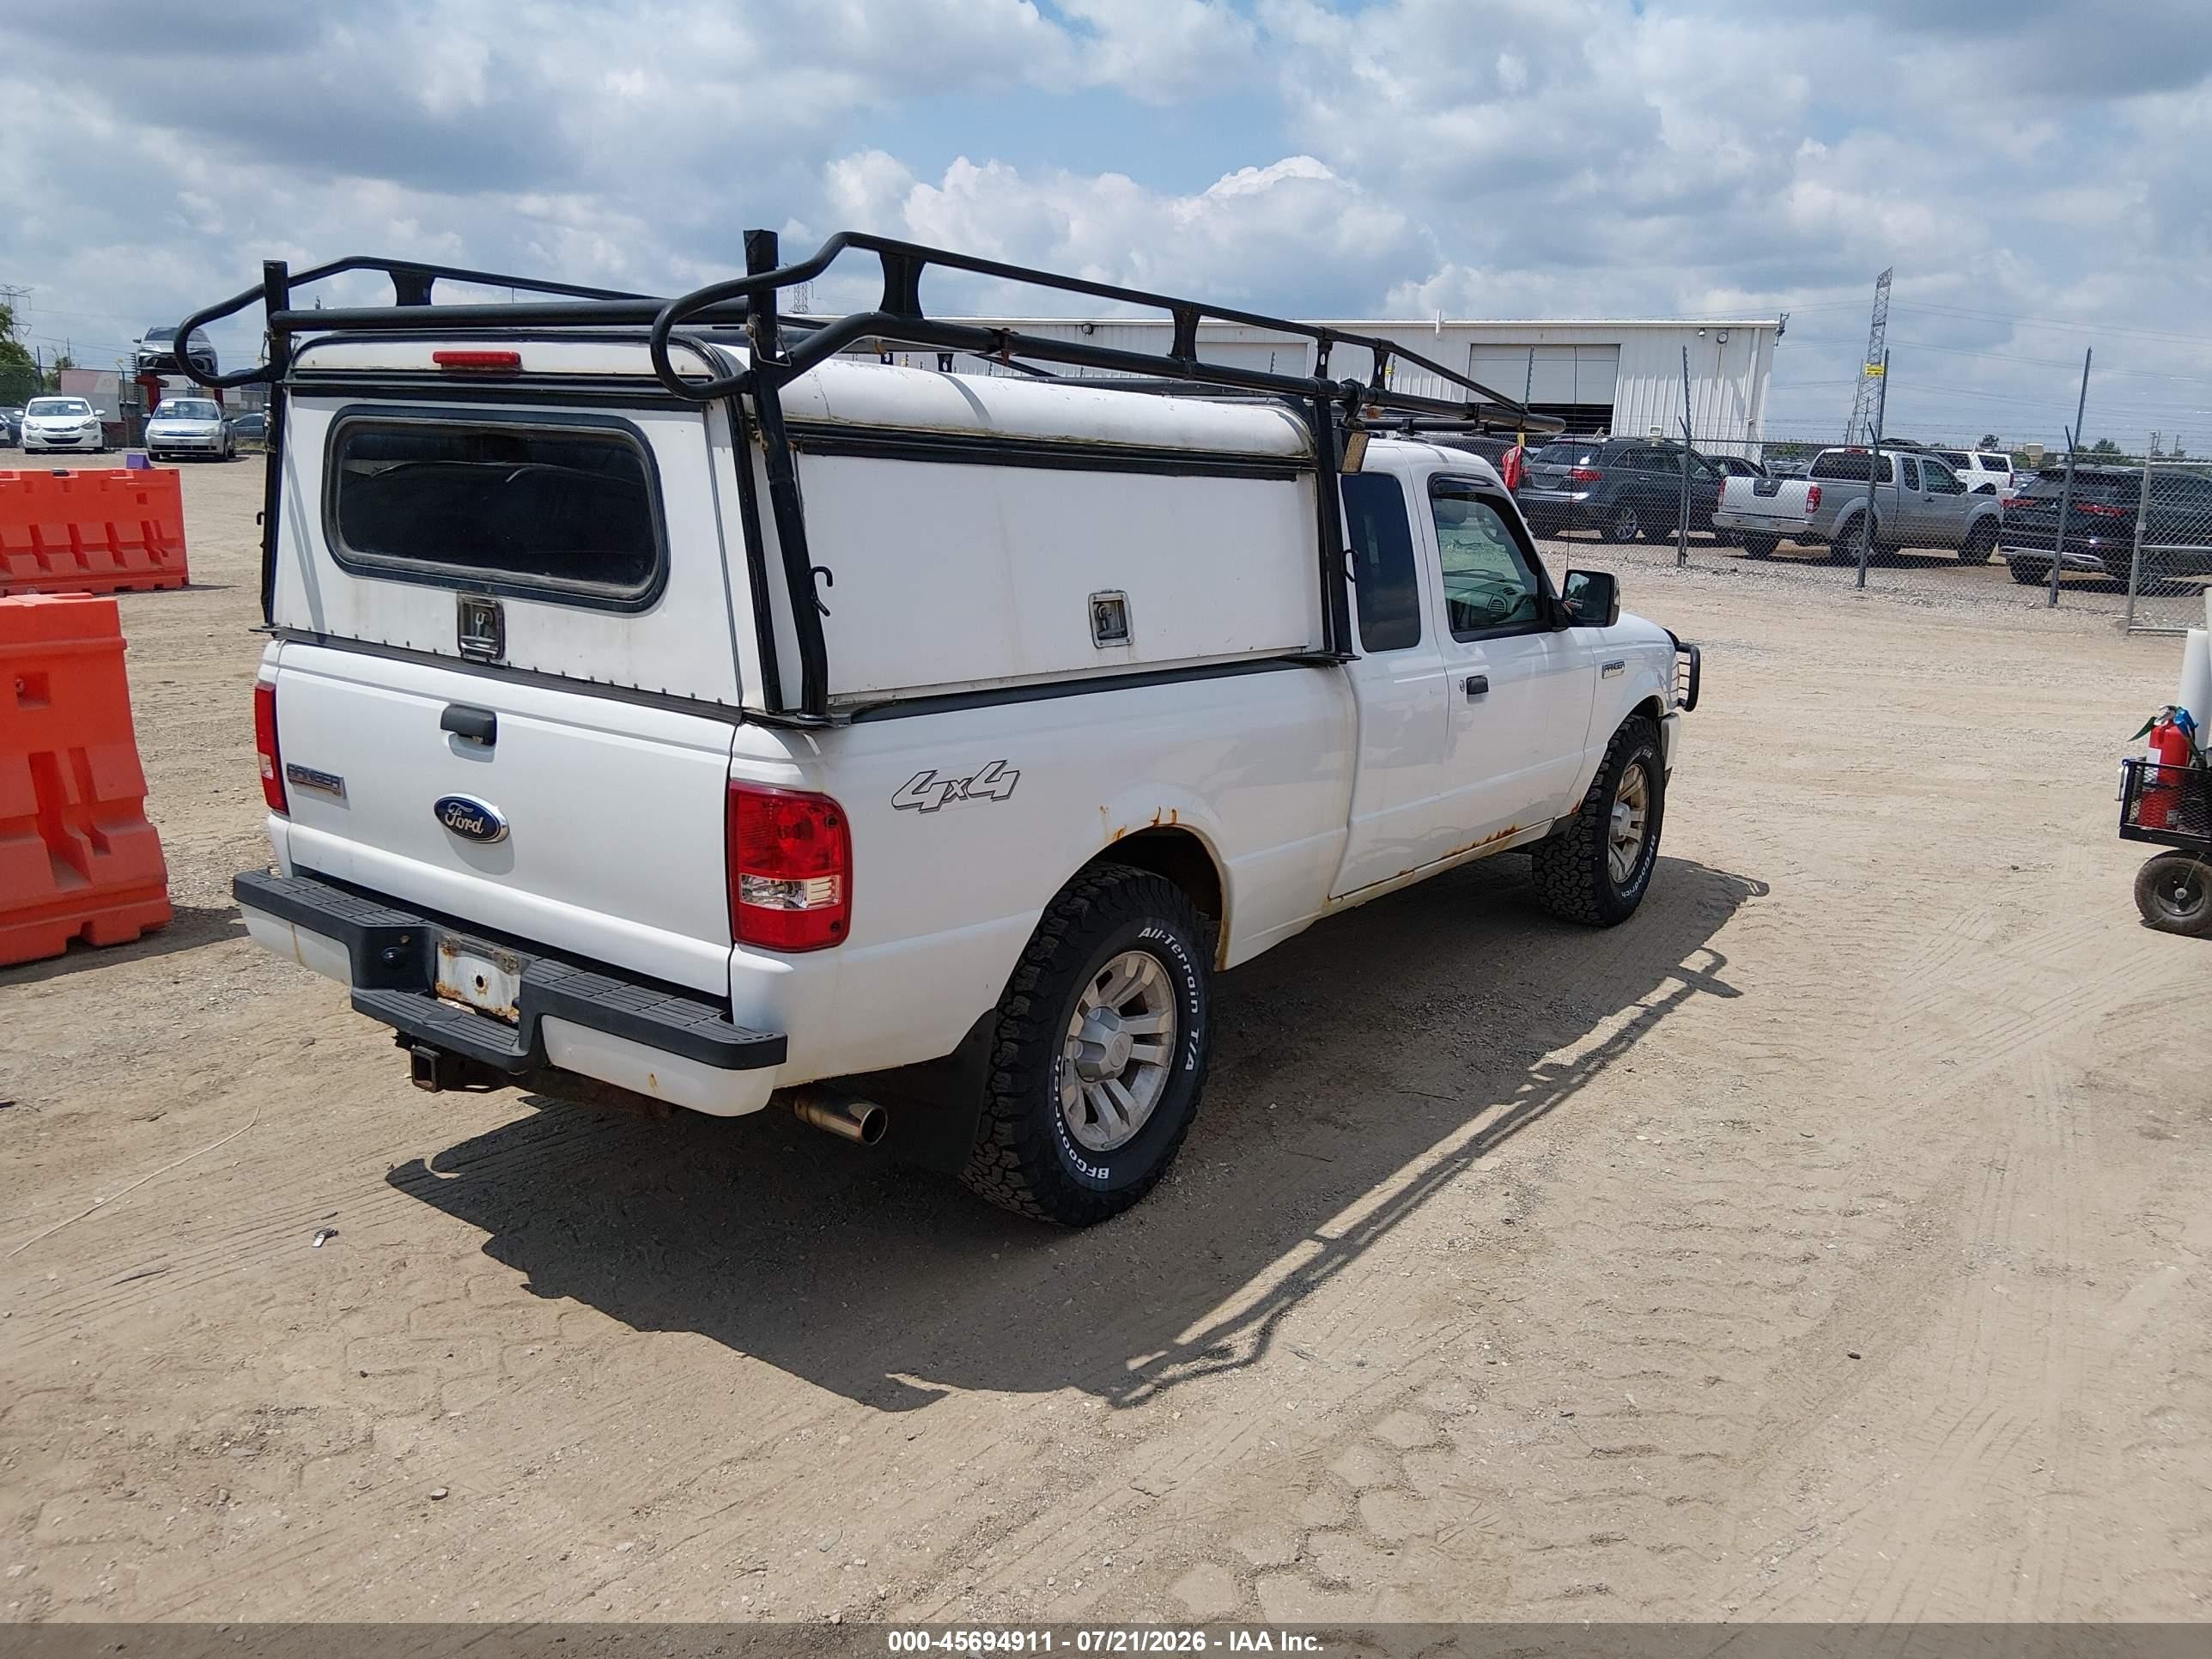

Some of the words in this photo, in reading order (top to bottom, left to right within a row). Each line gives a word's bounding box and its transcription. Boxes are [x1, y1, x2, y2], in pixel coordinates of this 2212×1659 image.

[287, 763, 342, 789] RANGER
[891, 759, 1021, 815] 4x4
[445, 802, 484, 835] Ford
[1138, 927, 1200, 1014] All-Terrain
[1184, 1027, 1200, 1071] T/A
[1054, 1054, 1110, 1180] BFGoodrich
